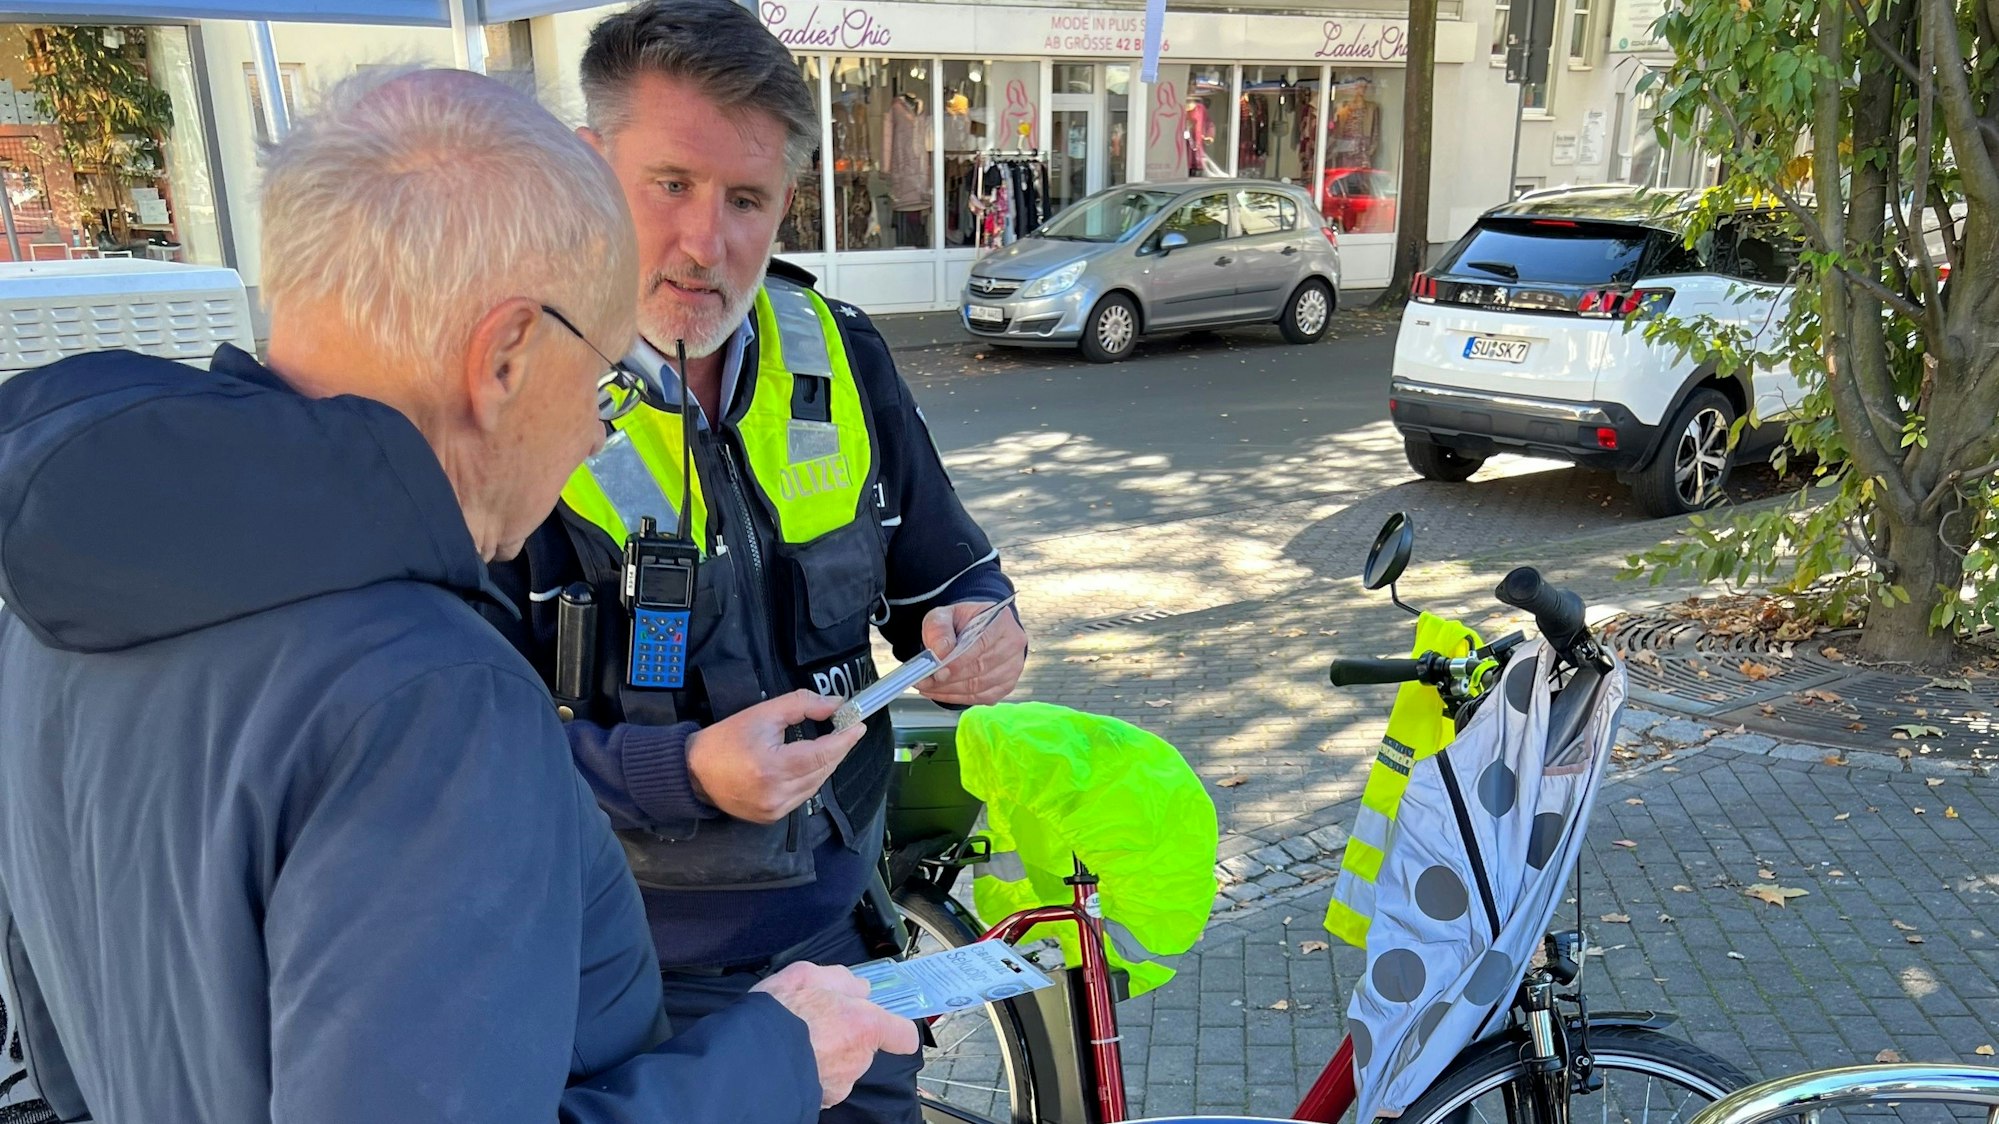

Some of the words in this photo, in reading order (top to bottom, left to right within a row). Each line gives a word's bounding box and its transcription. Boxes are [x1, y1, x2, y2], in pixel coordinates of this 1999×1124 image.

[841, 7, 891, 49] Chic
[1050, 16, 1089, 30] MODE
[1092, 17, 1106, 31] IN
[1109, 18, 1137, 32] PLUS
[1044, 35, 1061, 49] AB
[1064, 34, 1113, 50] GRÖSSE
[1116, 38, 1130, 51] 42
[1134, 38, 1145, 51] BI
[1314, 20, 1379, 58] Ladies
[1471, 340, 1491, 355] SU
[1496, 342, 1515, 358] SK
[1516, 344, 1527, 359] 7
[780, 455, 854, 501] OLIZE
